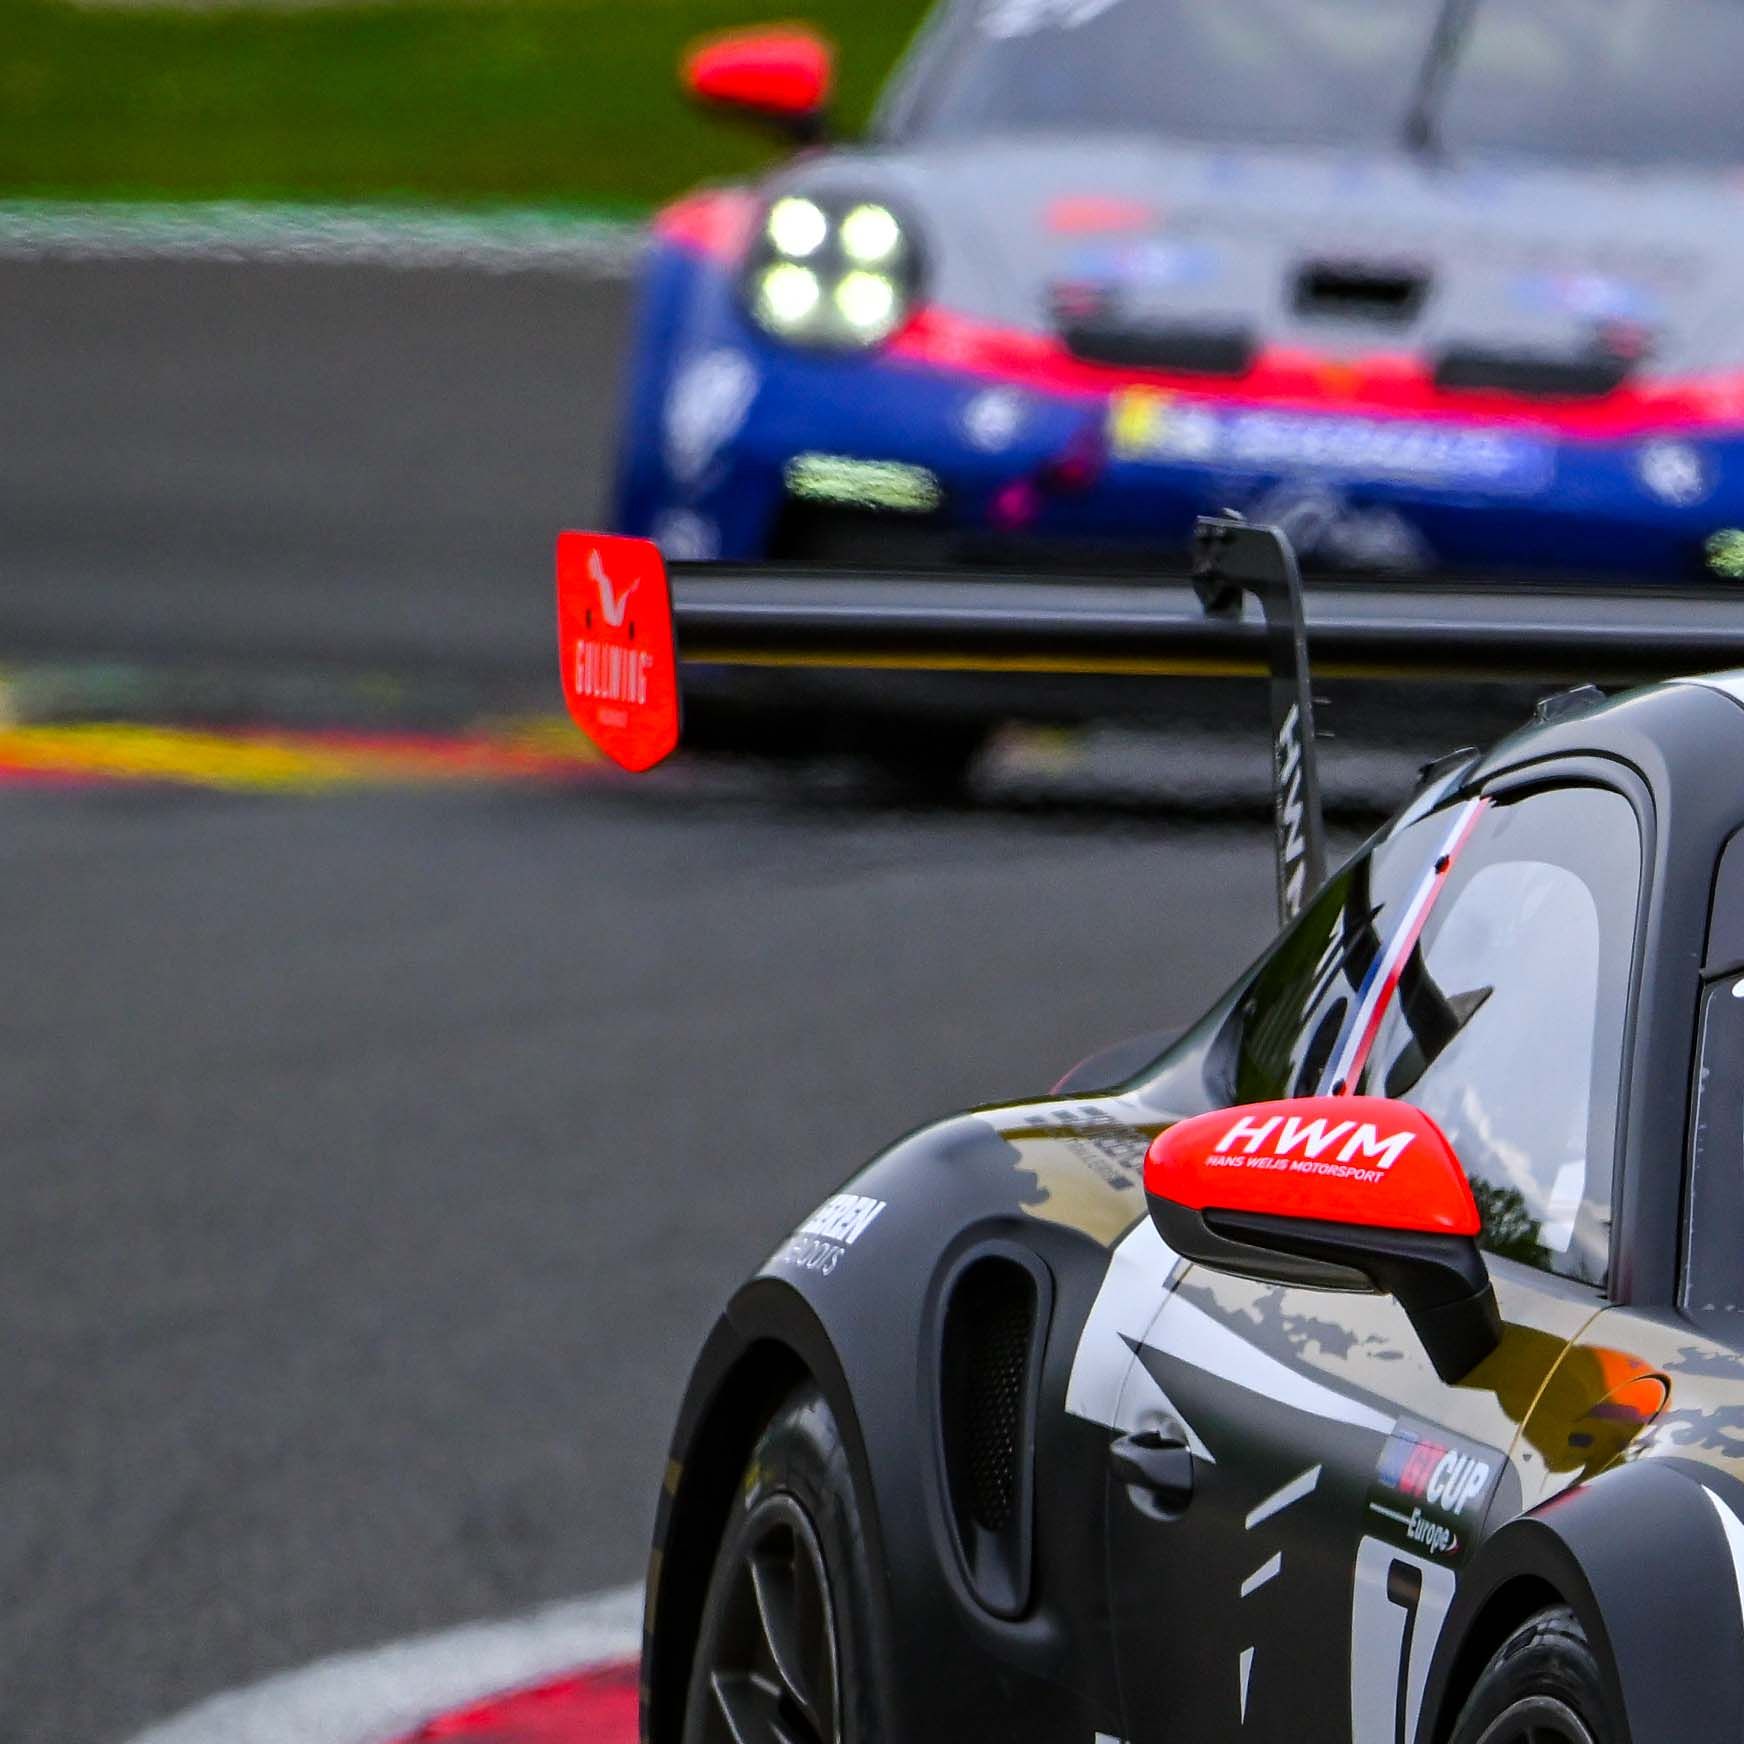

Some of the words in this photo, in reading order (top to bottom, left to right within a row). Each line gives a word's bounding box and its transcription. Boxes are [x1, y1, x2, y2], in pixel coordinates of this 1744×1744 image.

[1215, 1115, 1416, 1169] HWM
[1206, 1155, 1244, 1168] HANS
[1290, 1161, 1385, 1183] MOTORSPORT
[1407, 1506, 1451, 1555] Europe
